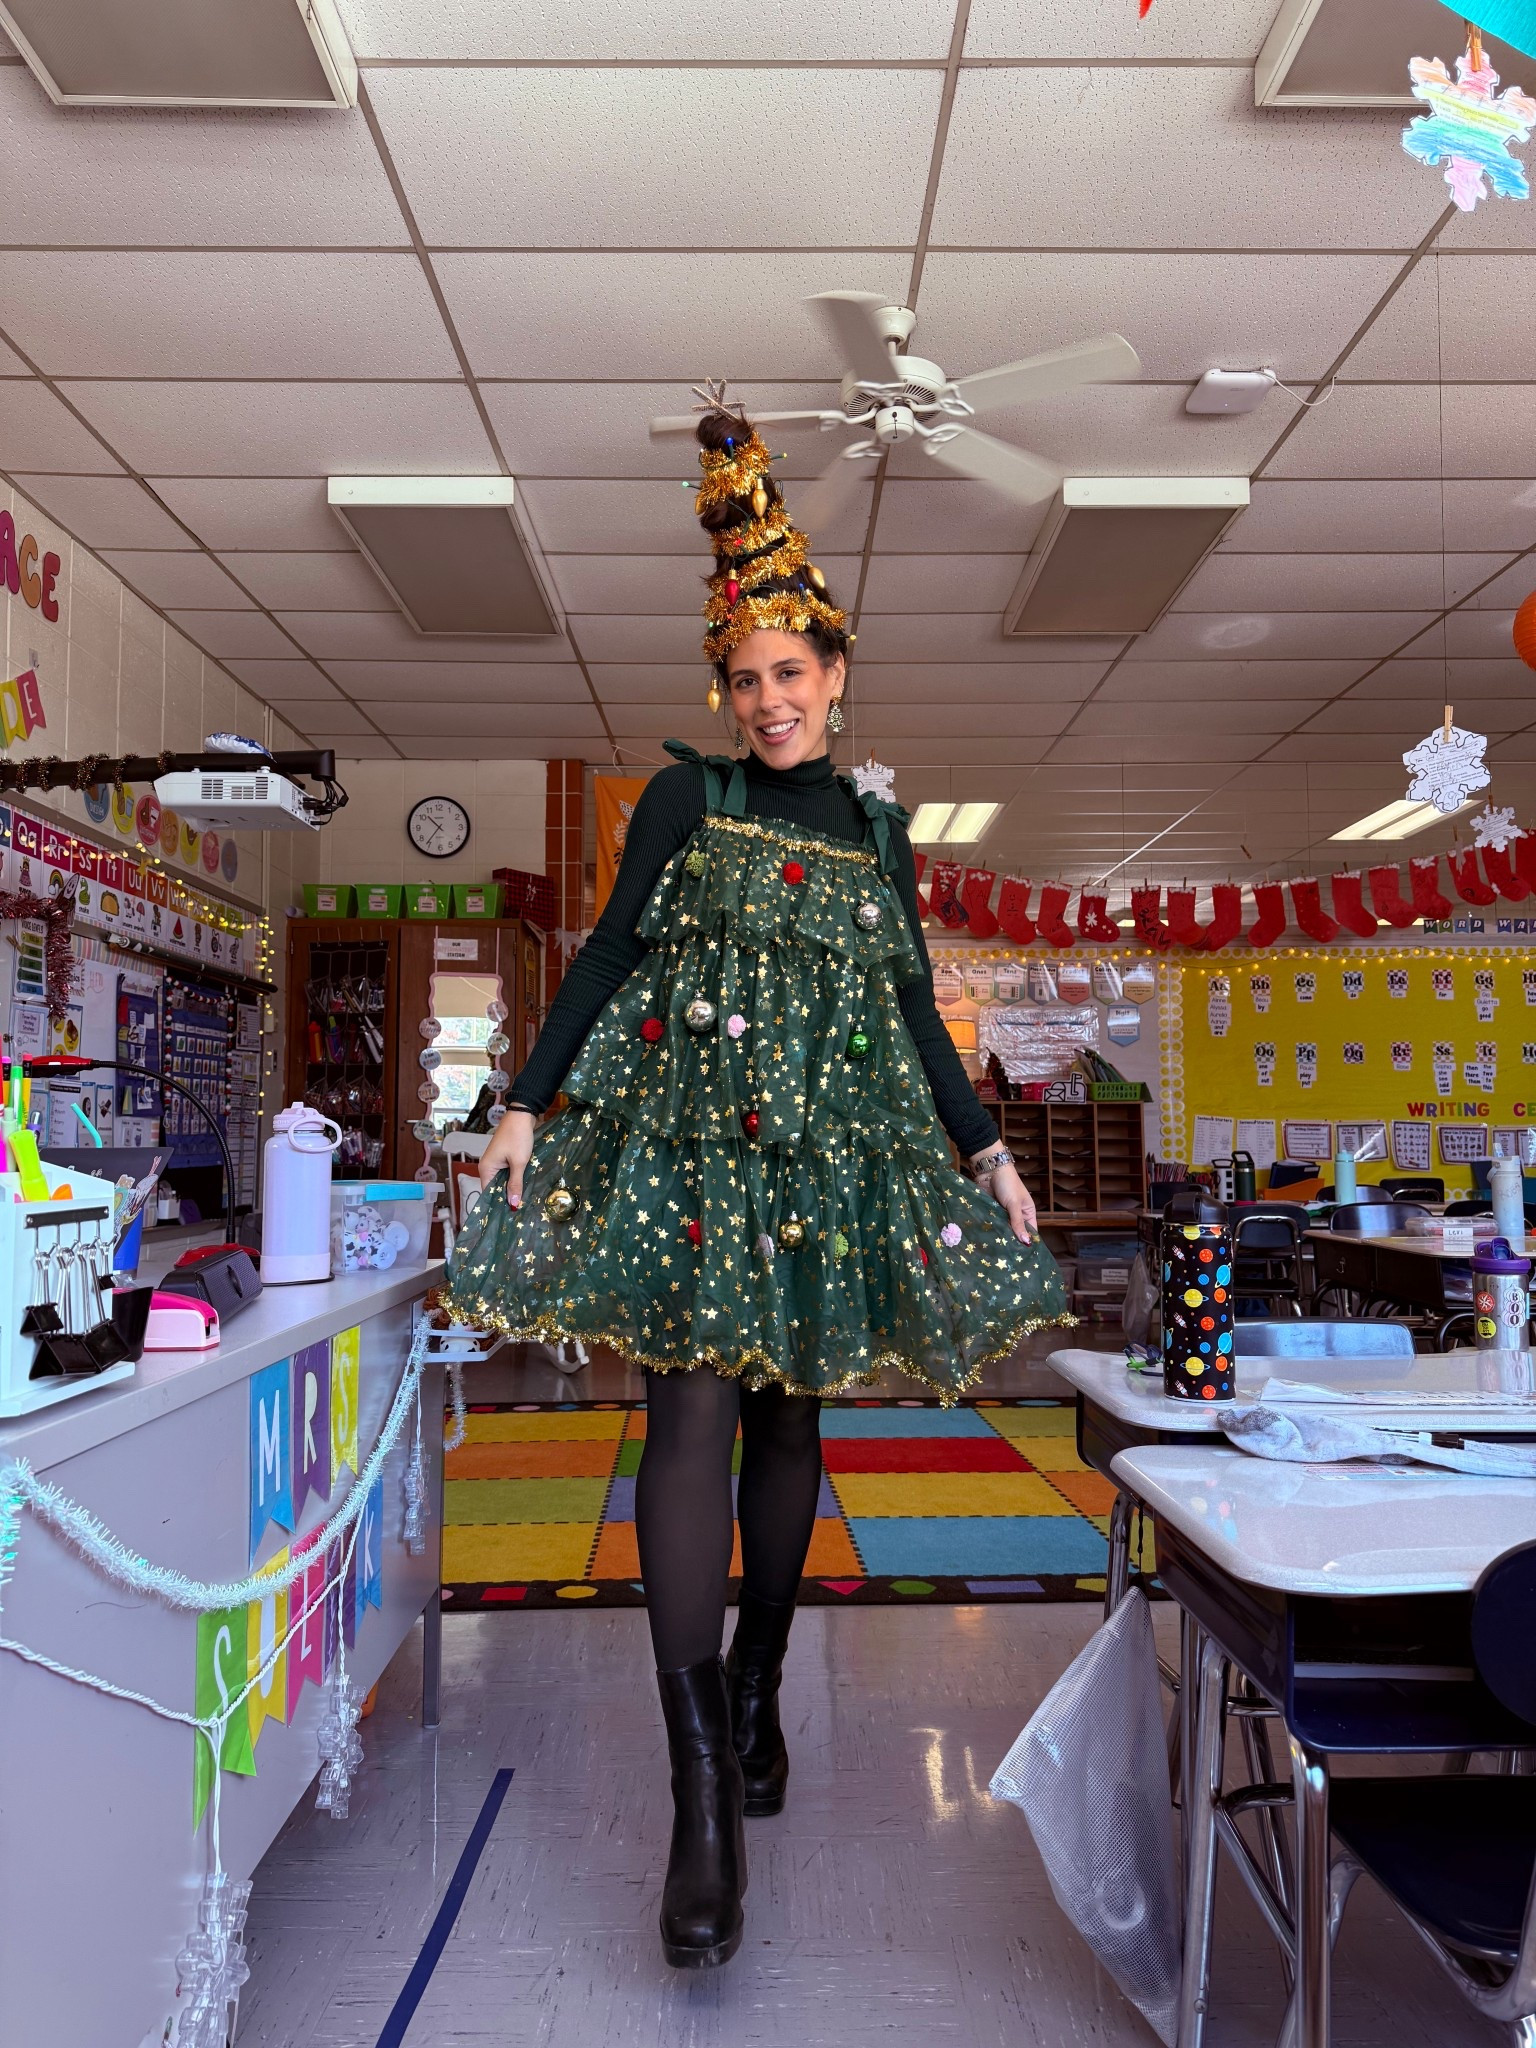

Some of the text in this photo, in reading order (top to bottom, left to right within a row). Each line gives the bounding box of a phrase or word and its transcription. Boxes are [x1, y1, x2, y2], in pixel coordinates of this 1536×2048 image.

[454, 813, 460, 821] 2
[17, 821, 37, 856] Qq
[49, 834, 67, 860] Rr
[79, 846, 92, 871] Ss
[105, 857, 117, 881] Tt
[128, 868, 142, 891] Uu
[151, 877, 165, 900] Vv
[171, 887, 188, 910] Ww
[1425, 920, 1536, 929] WORD WA
[1297, 978, 1314, 987] Cc
[1344, 976, 1362, 986] Dd
[1390, 975, 1405, 985] Ee
[1435, 973, 1450, 984] Ff
[1475, 975, 1493, 989] Gg
[1523, 974, 1536, 984] H
[1210, 981, 1228, 991] Aa
[1252, 980, 1270, 990] Bb
[1256, 1046, 1273, 1057] Oo
[1298, 1047, 1314, 1060] Pp
[1345, 1047, 1363, 1060] Qq
[1393, 1046, 1410, 1056] Rr
[1436, 1045, 1450, 1056] Ss
[1480, 1045, 1492, 1056] Tt
[1523, 1046, 1536, 1057] U
[1407, 1102, 1490, 1117] WRITING
[1510, 1293, 1519, 1325] BOO
[258, 1352, 351, 1507] MRS
[213, 1504, 375, 1748] SULK
